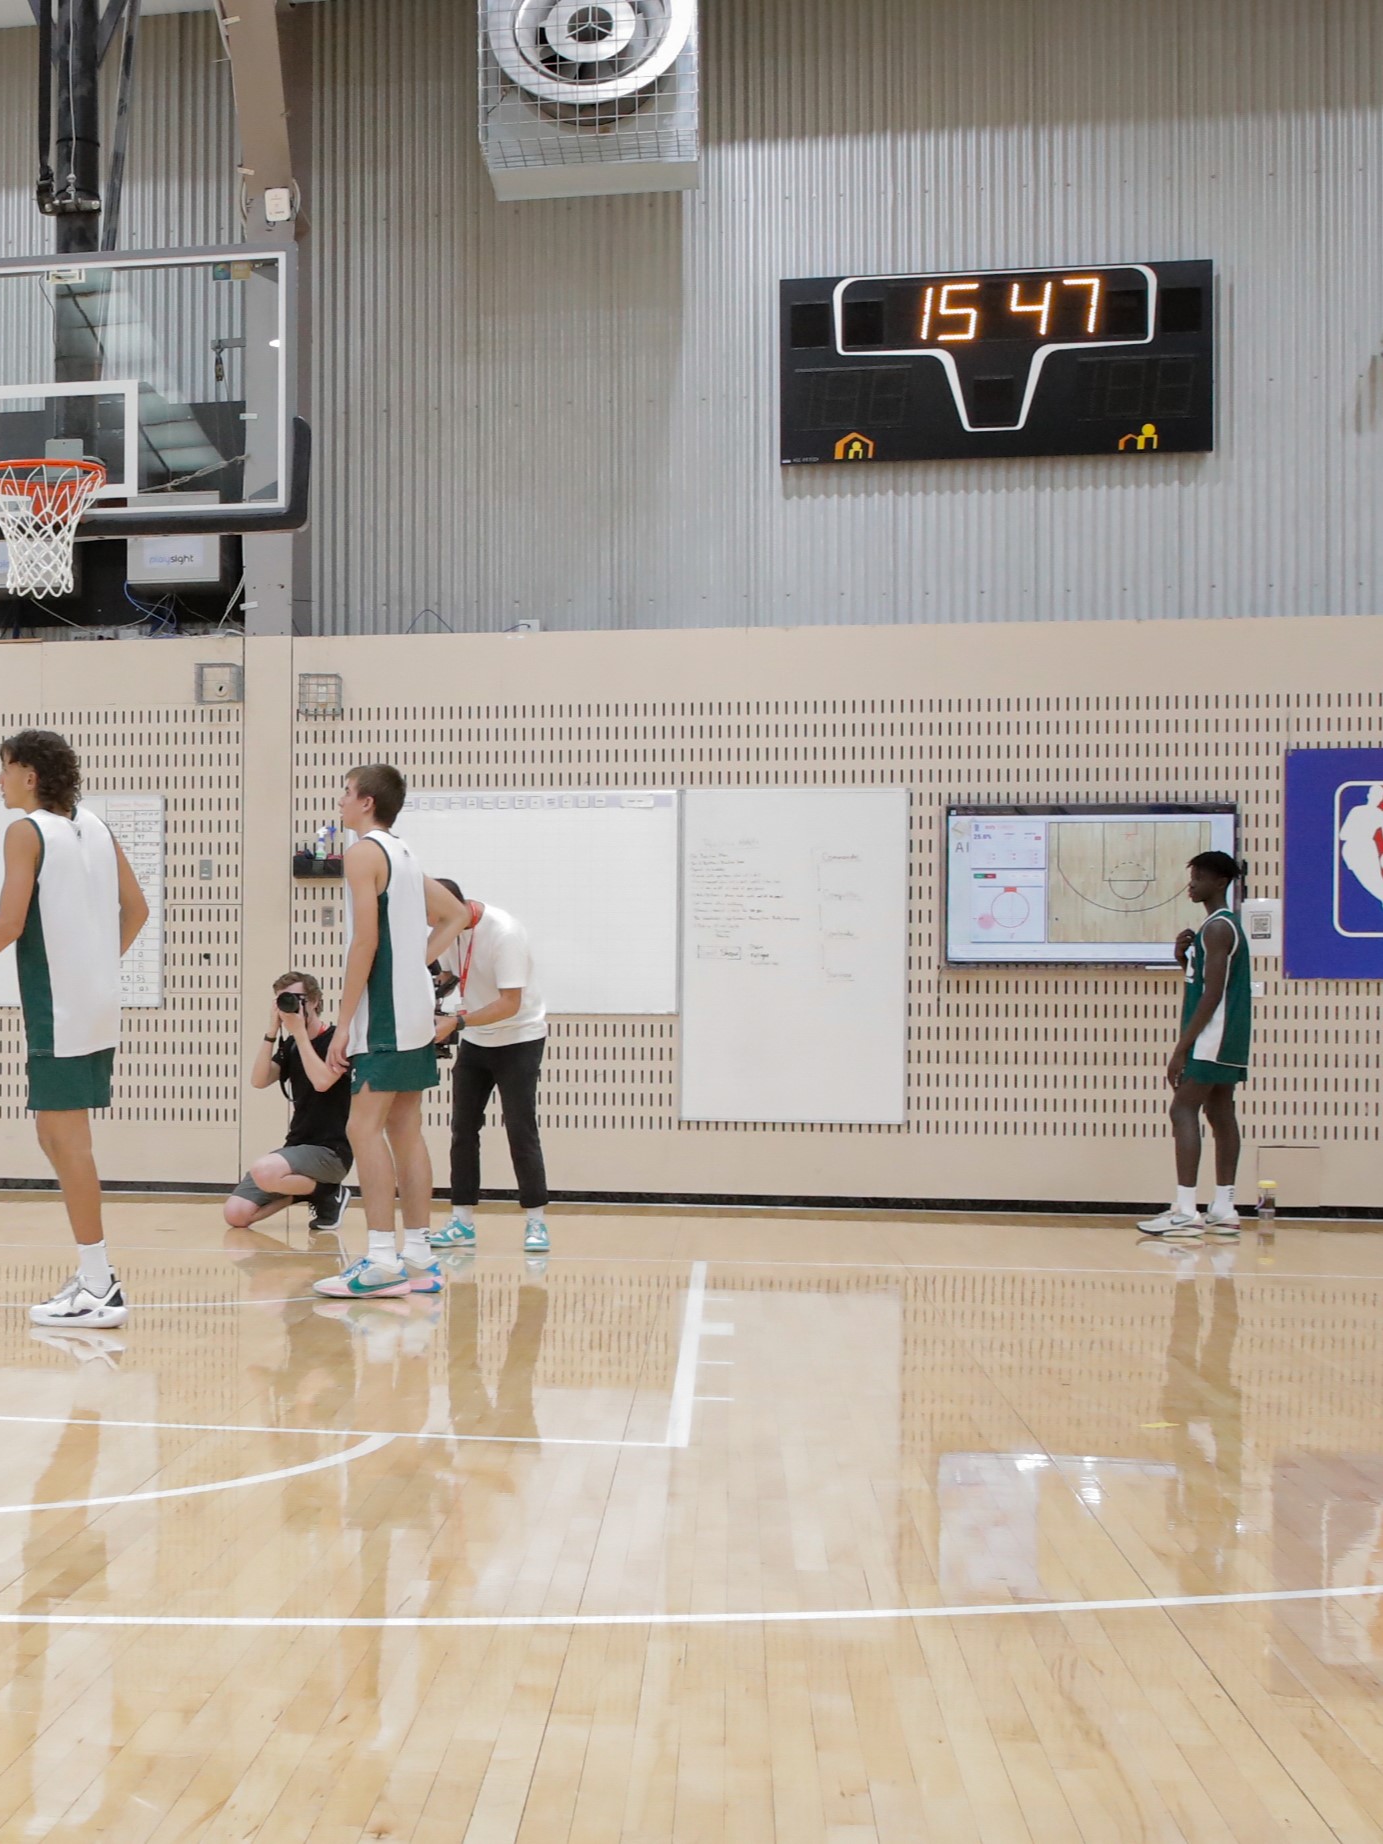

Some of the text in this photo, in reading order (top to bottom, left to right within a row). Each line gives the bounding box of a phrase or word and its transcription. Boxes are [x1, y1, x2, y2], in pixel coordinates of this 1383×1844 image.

[920, 277, 1100, 341] 15 47
[149, 554, 194, 565] playsight
